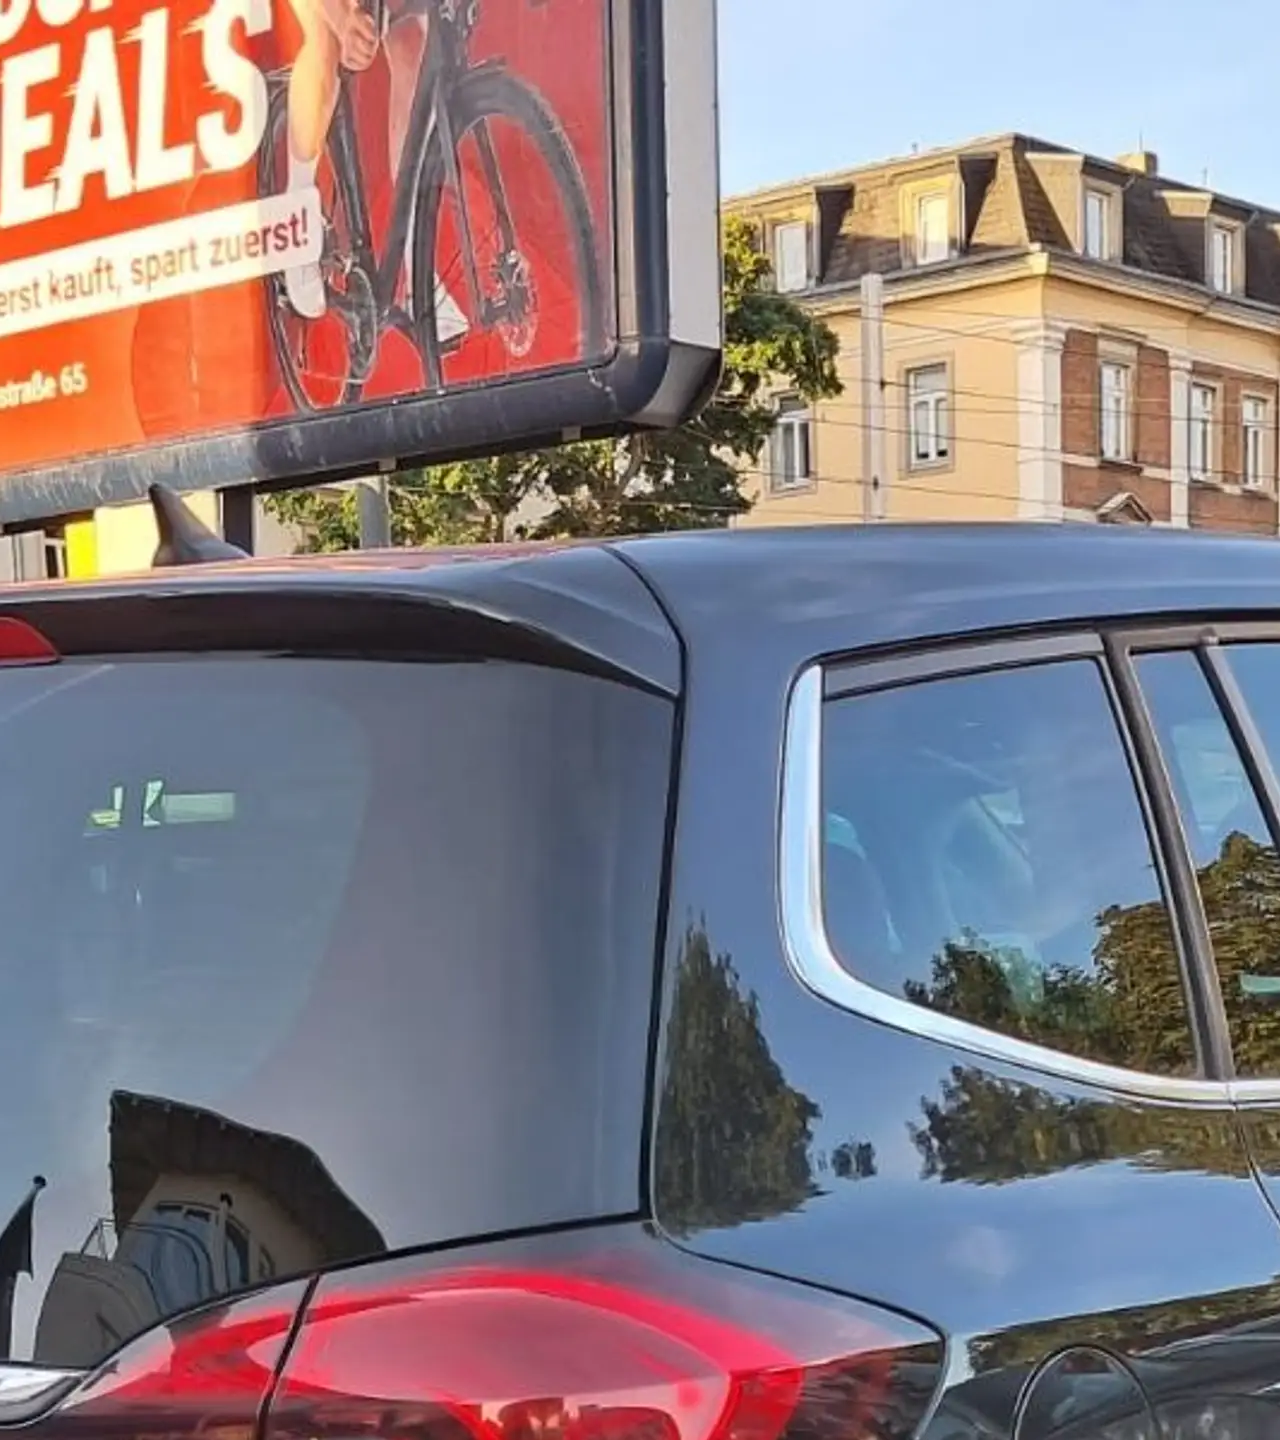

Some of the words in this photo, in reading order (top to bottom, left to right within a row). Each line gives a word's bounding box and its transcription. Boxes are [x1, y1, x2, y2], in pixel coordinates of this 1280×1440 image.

[48, 256, 123, 306] kauft,
[130, 237, 200, 293] spart
[208, 206, 310, 267] zuerst!
[59, 361, 89, 396] 65
